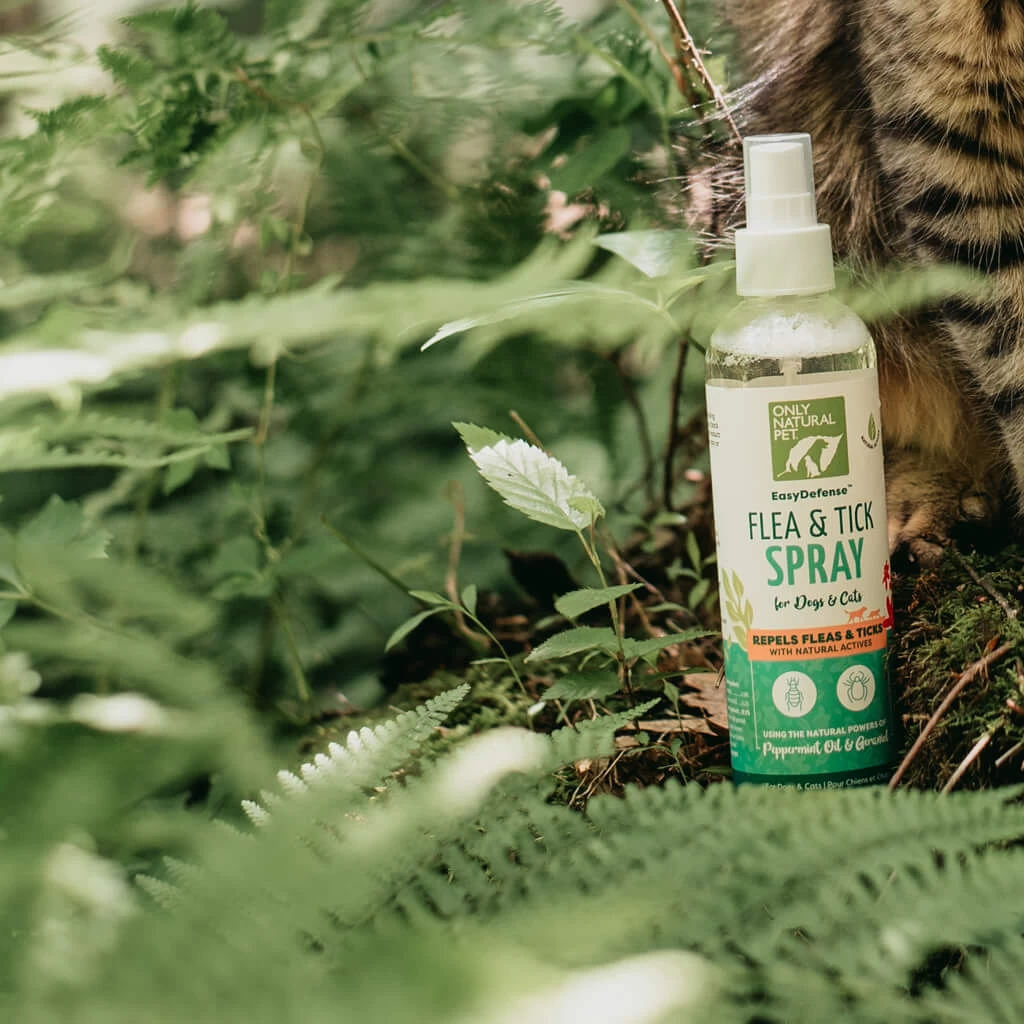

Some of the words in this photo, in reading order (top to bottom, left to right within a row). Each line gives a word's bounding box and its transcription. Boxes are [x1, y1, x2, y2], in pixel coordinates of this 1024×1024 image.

[773, 403, 810, 416] ONLY
[773, 414, 836, 429] NATURAL
[748, 511, 801, 540] FLEA
[809, 509, 828, 538] &
[834, 501, 874, 535] TICK
[765, 537, 864, 587] SPRAY
[774, 596, 790, 612] for
[794, 594, 824, 612] Dogs
[828, 594, 837, 607] &
[840, 588, 862, 606] Cats
[752, 634, 799, 646] REPELS
[802, 630, 842, 645] FLEAS
[845, 628, 854, 640] &
[856, 623, 883, 639] TICKS
[769, 647, 793, 656] WITH
[795, 644, 838, 656] NATURAL
[840, 639, 873, 652] ACTIVES
[762, 730, 787, 739] USING
[788, 729, 805, 738] THE
[806, 726, 847, 737] NATURAL
[847, 721, 878, 734] POWERS
[762, 740, 822, 760] Peppermint
[823, 738, 842, 754] Oil
[844, 738, 854, 752] &
